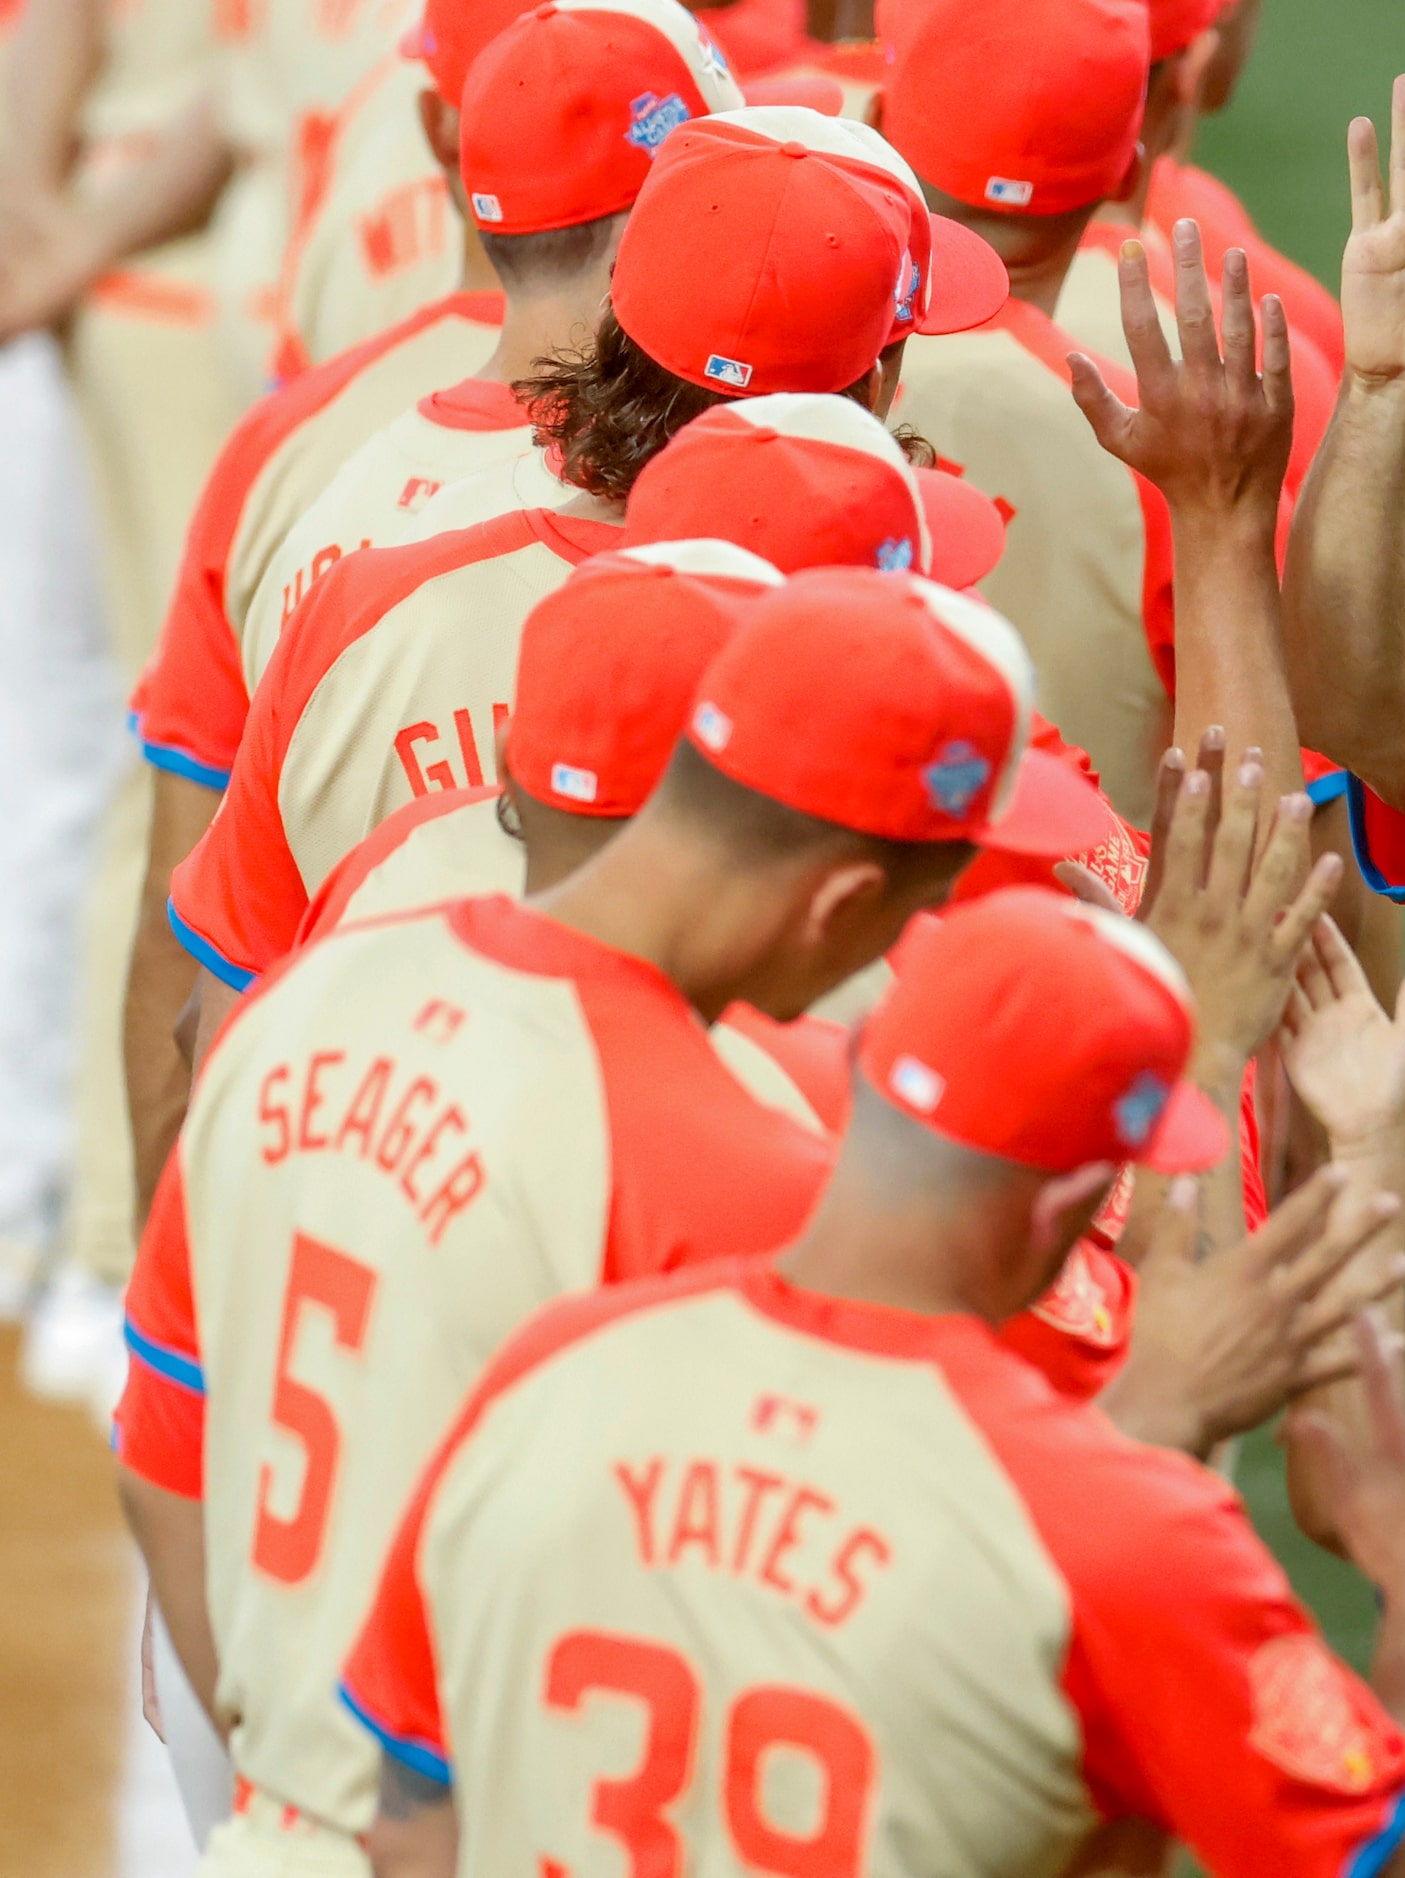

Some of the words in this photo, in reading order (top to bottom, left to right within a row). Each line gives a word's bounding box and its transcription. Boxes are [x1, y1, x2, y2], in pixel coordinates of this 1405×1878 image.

[259, 1048, 488, 1250] SEAGER
[250, 1227, 379, 1589] 5
[612, 1456, 893, 1631] YATES
[542, 1624, 880, 1878] 39
